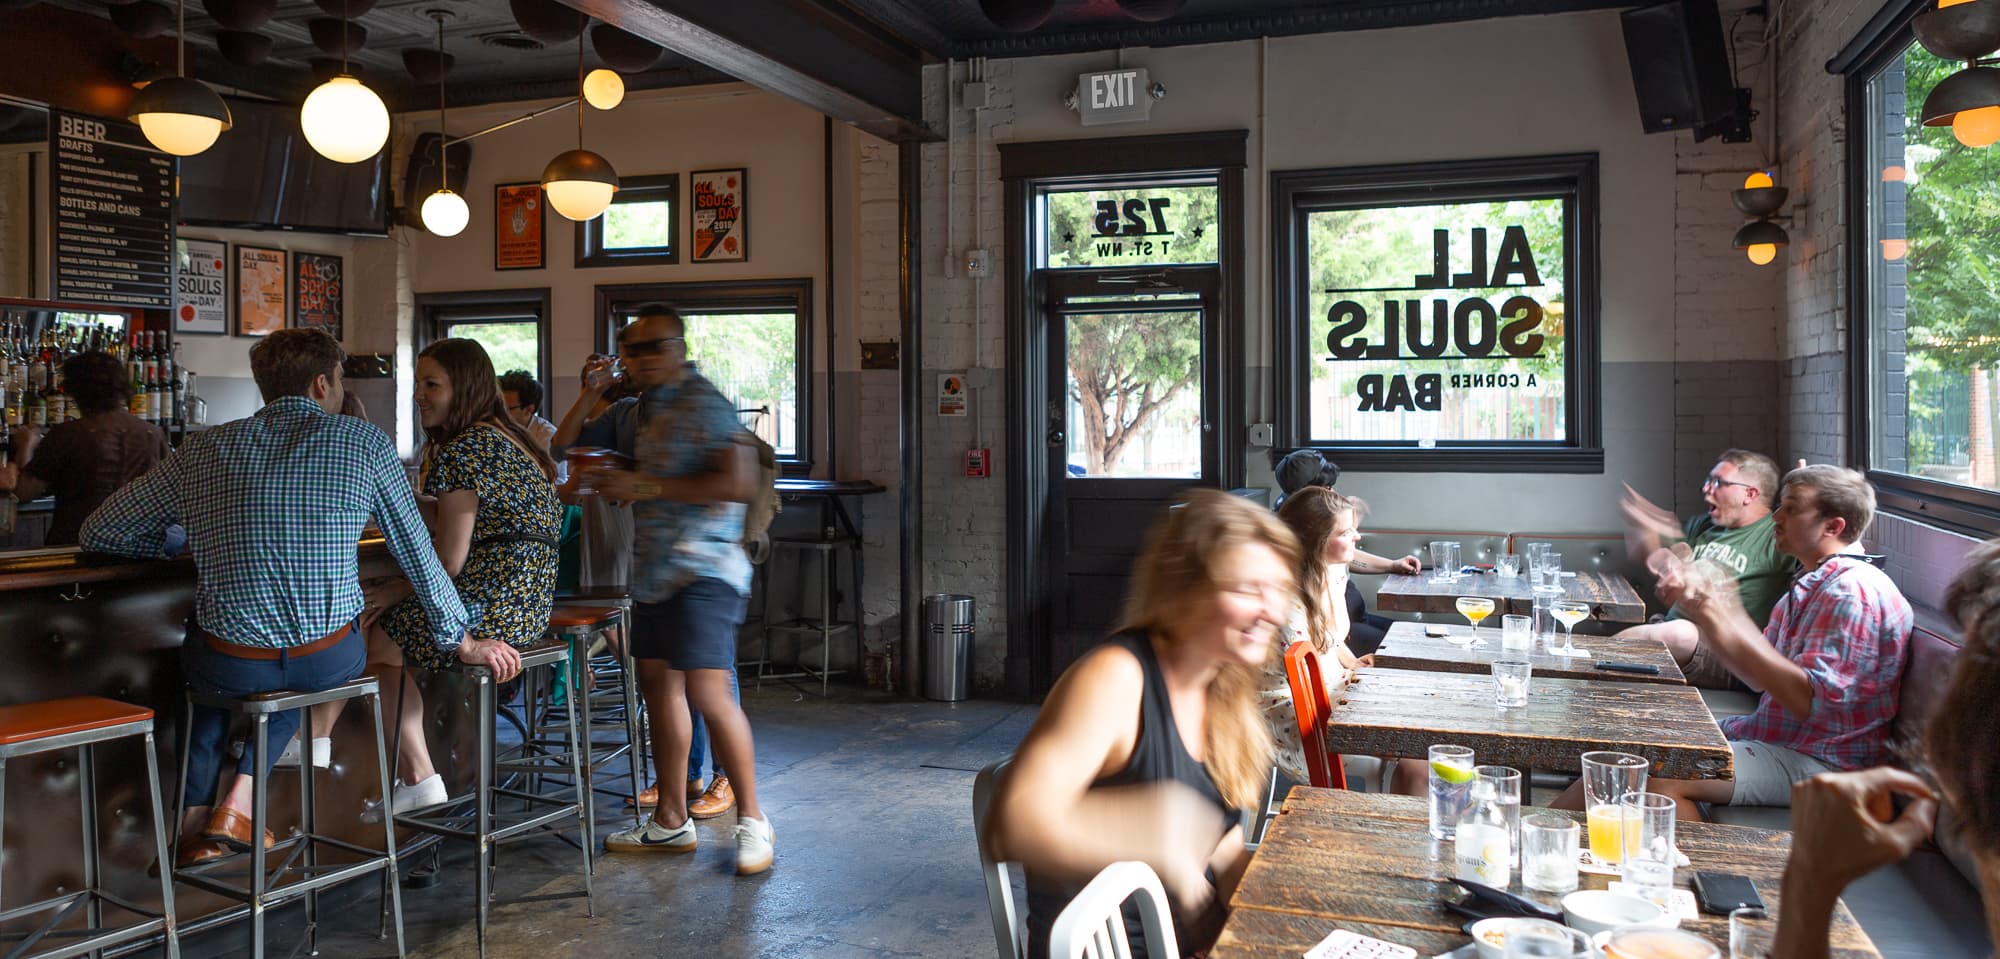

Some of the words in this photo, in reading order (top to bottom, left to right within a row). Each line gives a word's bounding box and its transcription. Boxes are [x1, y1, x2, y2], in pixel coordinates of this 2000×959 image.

[1091, 72, 1136, 109] EXIT
[60, 115, 106, 140] BEER
[60, 139, 94, 153] DRAFTS
[695, 181, 715, 193] ALL
[60, 197, 97, 210] BOTTLES
[98, 203, 116, 213] AND
[118, 205, 141, 216] CANS
[699, 193, 735, 207] SOULS
[718, 207, 741, 219] DAY
[243, 251, 255, 261] ALL
[178, 259, 204, 276] ALL
[243, 261, 257, 270] DAY
[300, 263, 321, 278] ALL
[178, 277, 222, 295] SOULS
[300, 279, 338, 297] SOULS
[199, 296, 216, 307] DAY
[300, 294, 325, 310] DAY
[968, 449, 982, 457] FIRE
[1690, 541, 1748, 574] UFFALO
[1456, 855, 1488, 868] gram's
